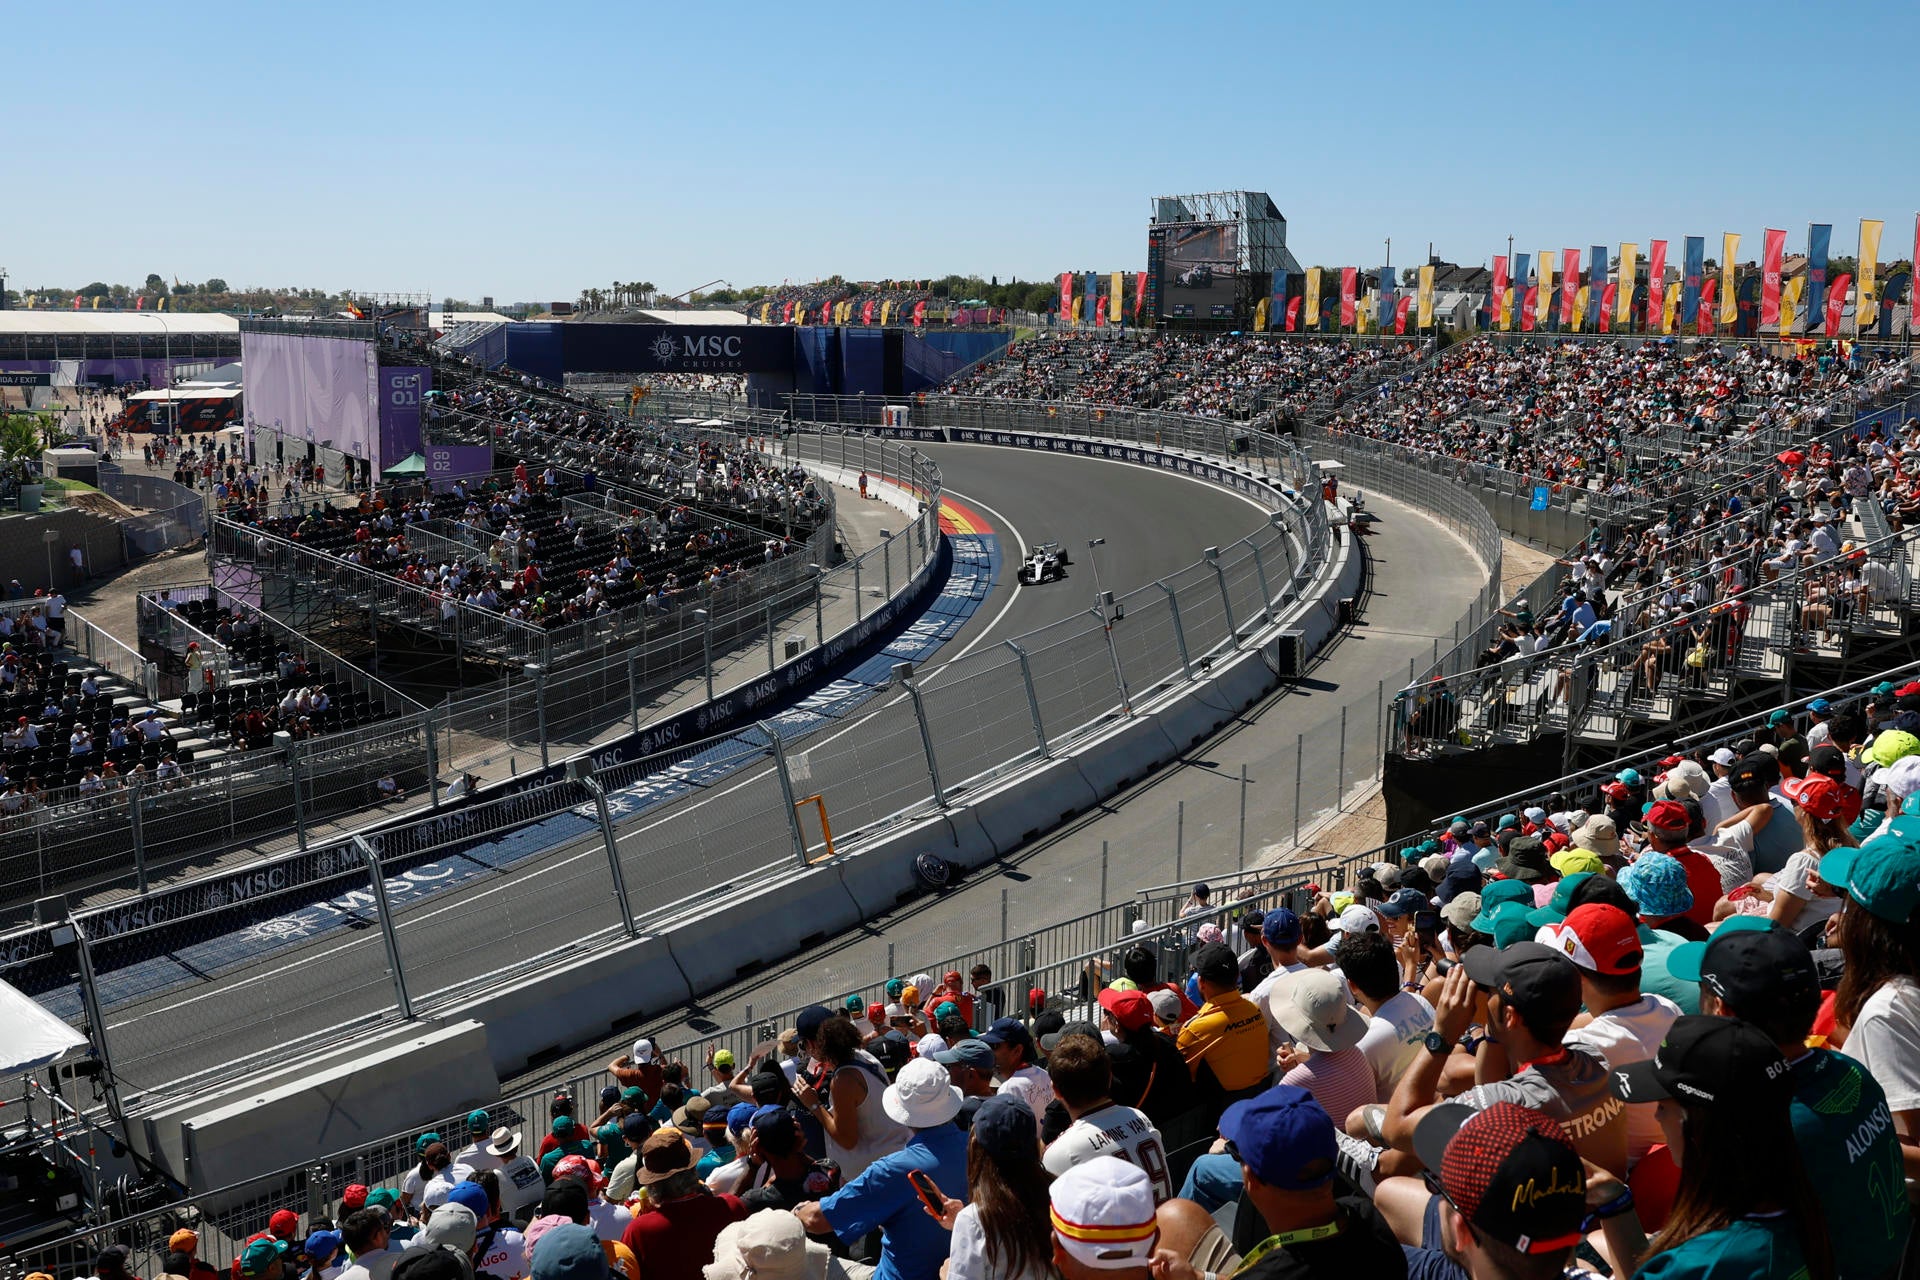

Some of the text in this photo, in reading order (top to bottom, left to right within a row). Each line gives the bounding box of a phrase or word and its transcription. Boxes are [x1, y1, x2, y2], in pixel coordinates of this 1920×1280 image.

[683, 335, 741, 357] MSC
[20, 376, 37, 384] EXIT
[391, 376, 417, 390] GD
[391, 391, 417, 405] 01
[1001, 435, 1011, 443] MSC
[1020, 437, 1030, 445] MSC
[1038, 439, 1048, 447] MSC
[1057, 441, 1067, 449] MSC
[1076, 443, 1086, 452] MSC
[1094, 446, 1104, 454] MSC
[1113, 448, 1122, 457] MSC
[433, 452, 450, 460] GD
[1130, 451, 1140, 460] MSC
[1148, 454, 1157, 463] MSC
[1164, 457, 1173, 467] MSC
[433, 462, 451, 471] 02
[896, 618, 946, 640] MSC
[830, 640, 845, 658] MSC
[796, 657, 814, 679] MSC
[755, 678, 777, 701] MSC
[710, 700, 732, 723] MSC
[654, 722, 680, 748] MSC
[591, 748, 623, 772] MSC
[339, 835, 385, 867] MC
[231, 867, 285, 902] MSC
[312, 863, 454, 915] MSC
[1088, 1126, 1128, 1151] LAMINE
[1845, 1101, 1892, 1164] ALONSO
[1511, 1166, 1585, 1212] Madrid
